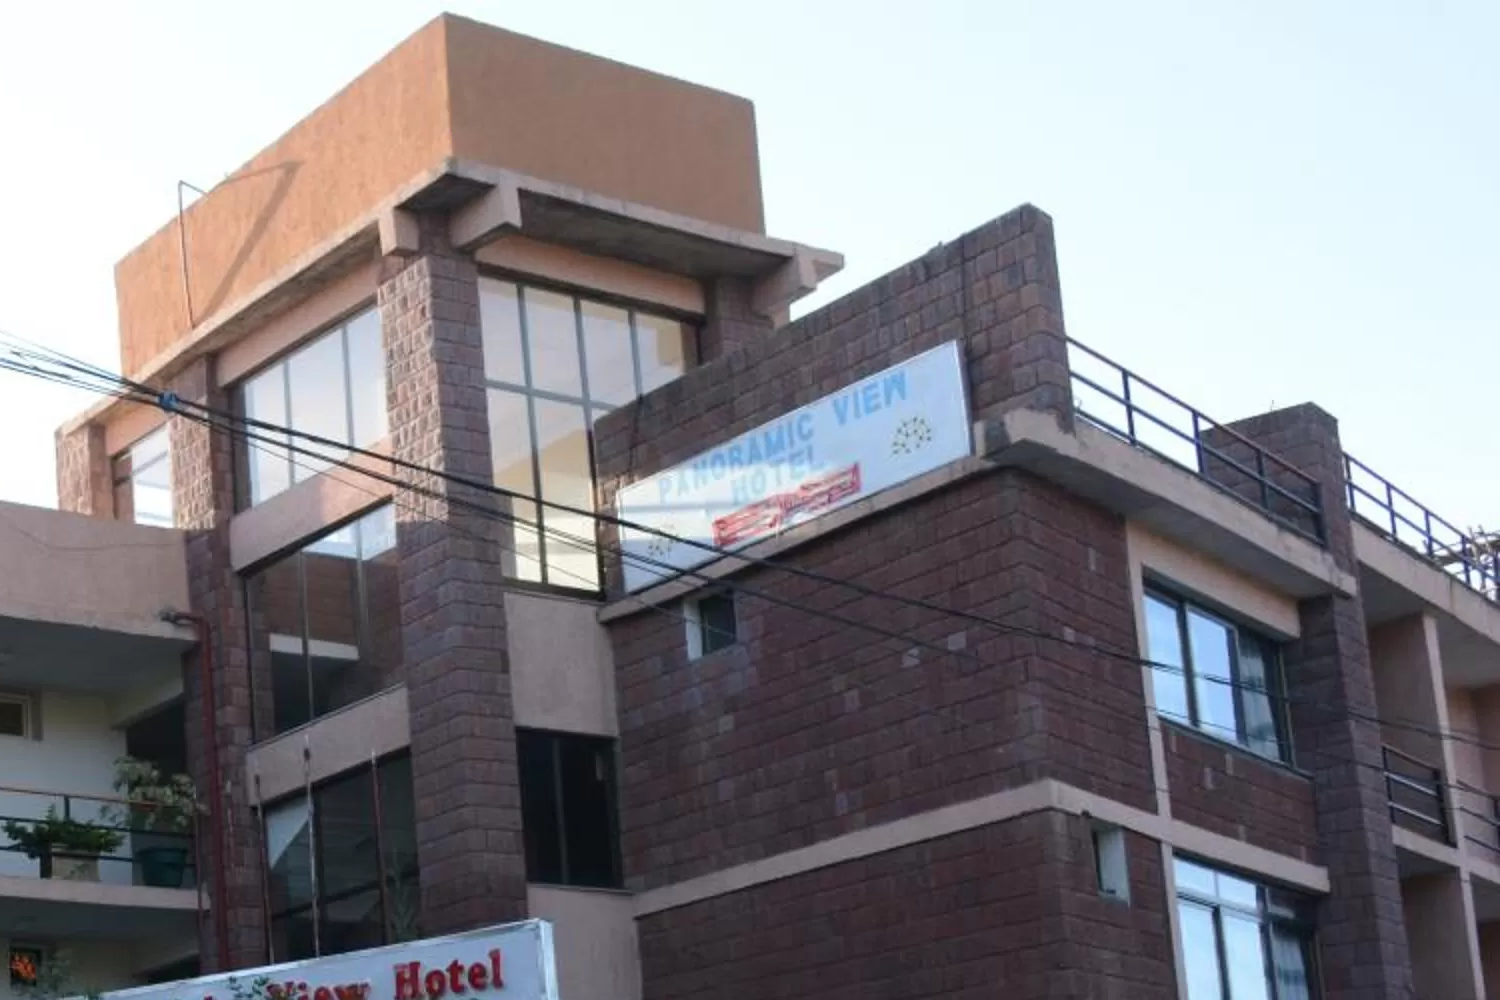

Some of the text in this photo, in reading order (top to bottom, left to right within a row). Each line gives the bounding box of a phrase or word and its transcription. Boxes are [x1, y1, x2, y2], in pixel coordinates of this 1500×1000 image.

[658, 372, 907, 505] PANORAMIC VIEW
[731, 445, 826, 507] HOTEL
